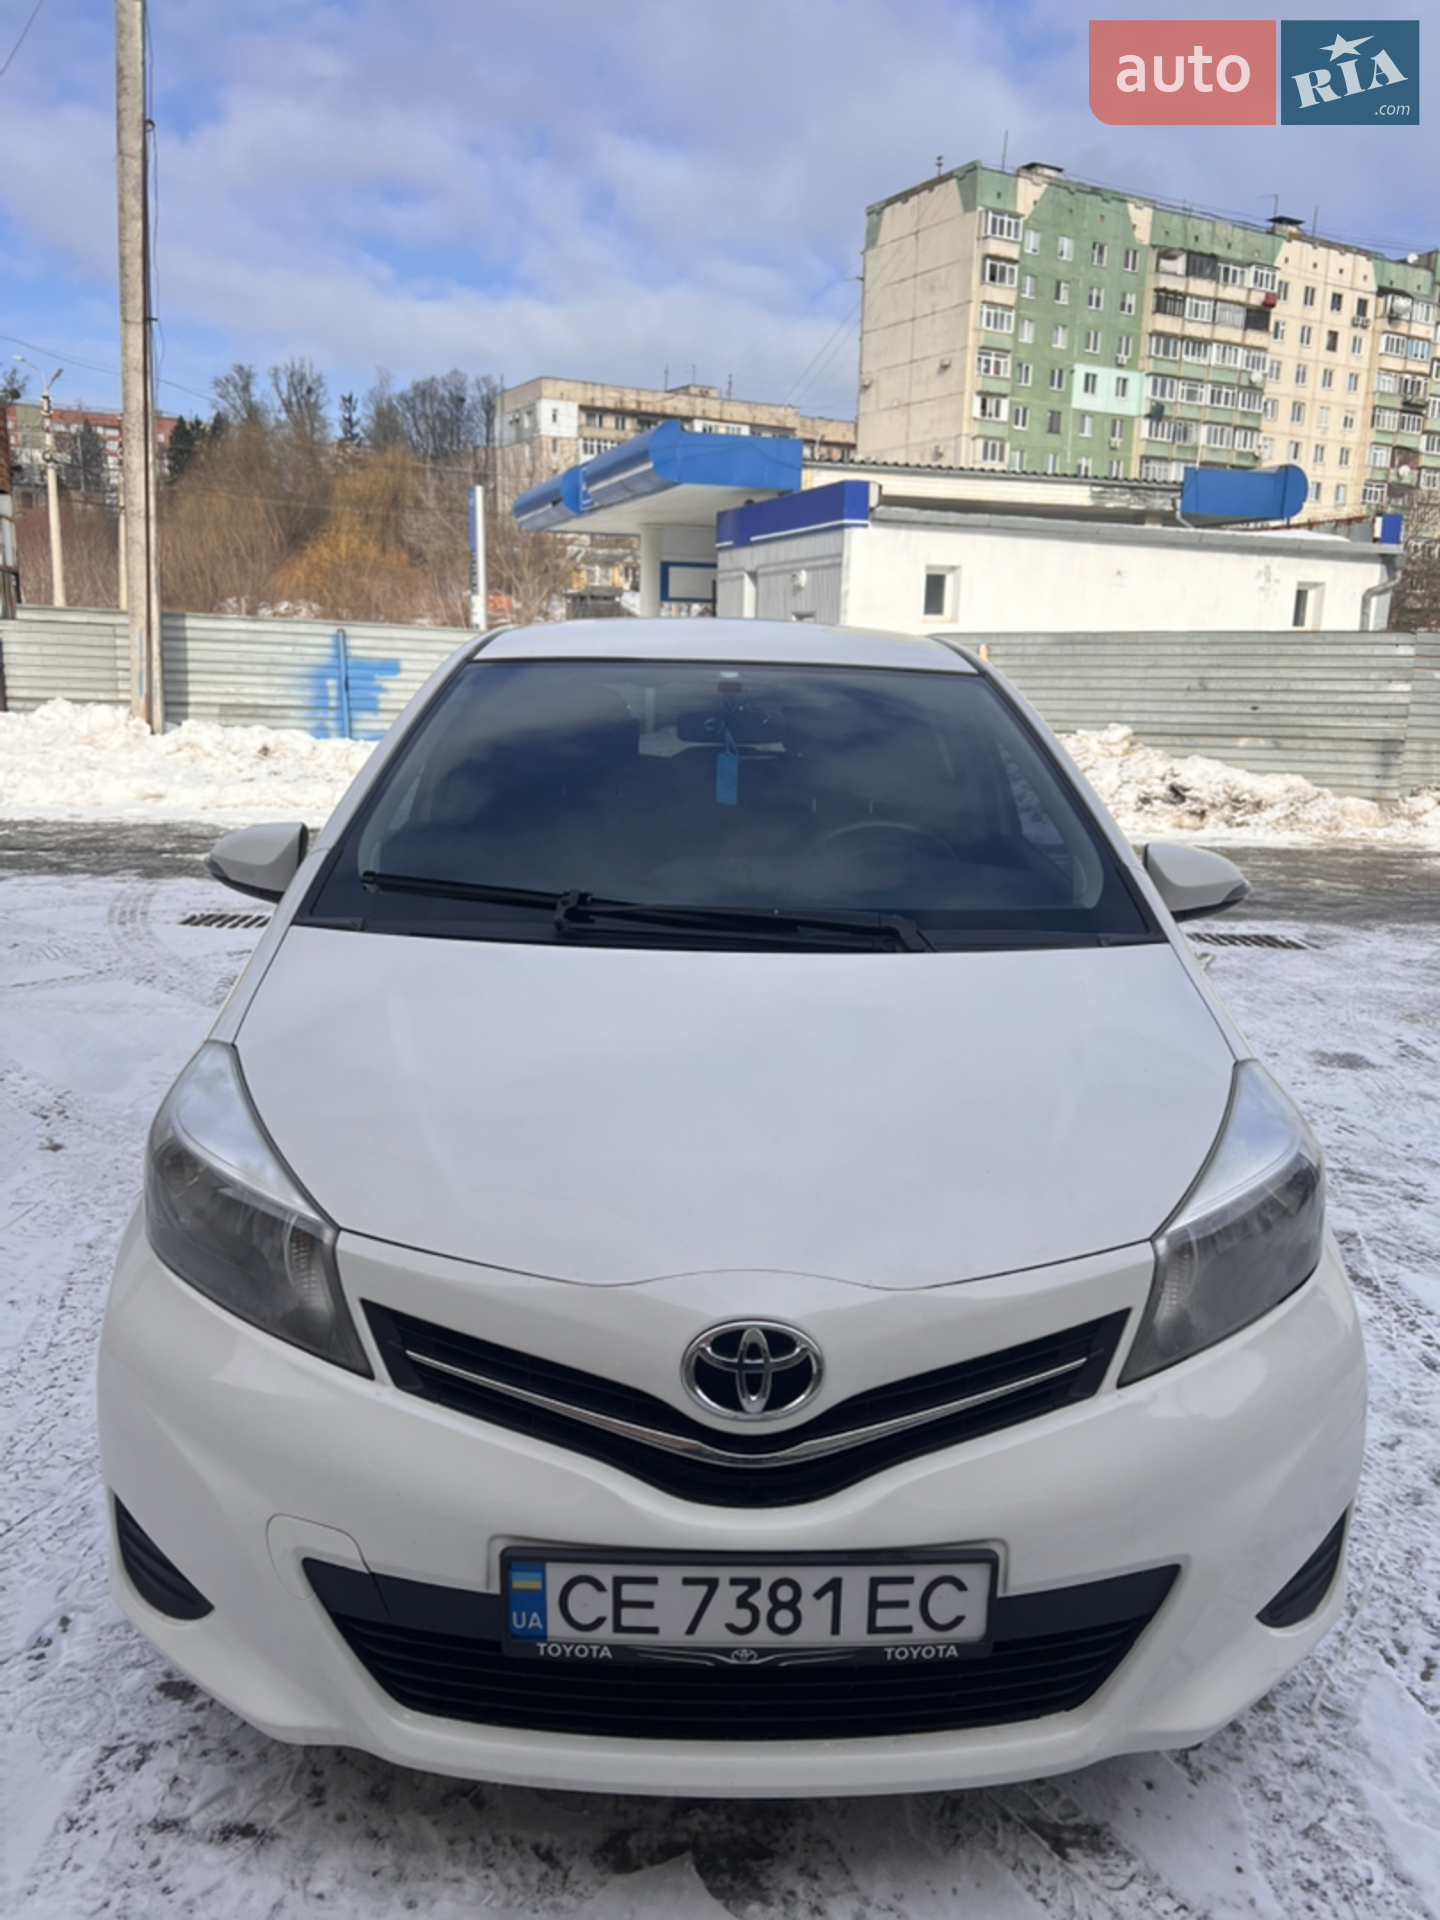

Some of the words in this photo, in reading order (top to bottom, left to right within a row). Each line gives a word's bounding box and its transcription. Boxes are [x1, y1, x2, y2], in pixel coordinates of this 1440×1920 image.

[558, 1574, 660, 1635] CE
[682, 1577, 842, 1637] 7381
[866, 1574, 969, 1635] EC
[511, 1611, 543, 1630] UA
[536, 1642, 613, 1660] TOYOTA
[884, 1644, 959, 1661] TOYOTA
